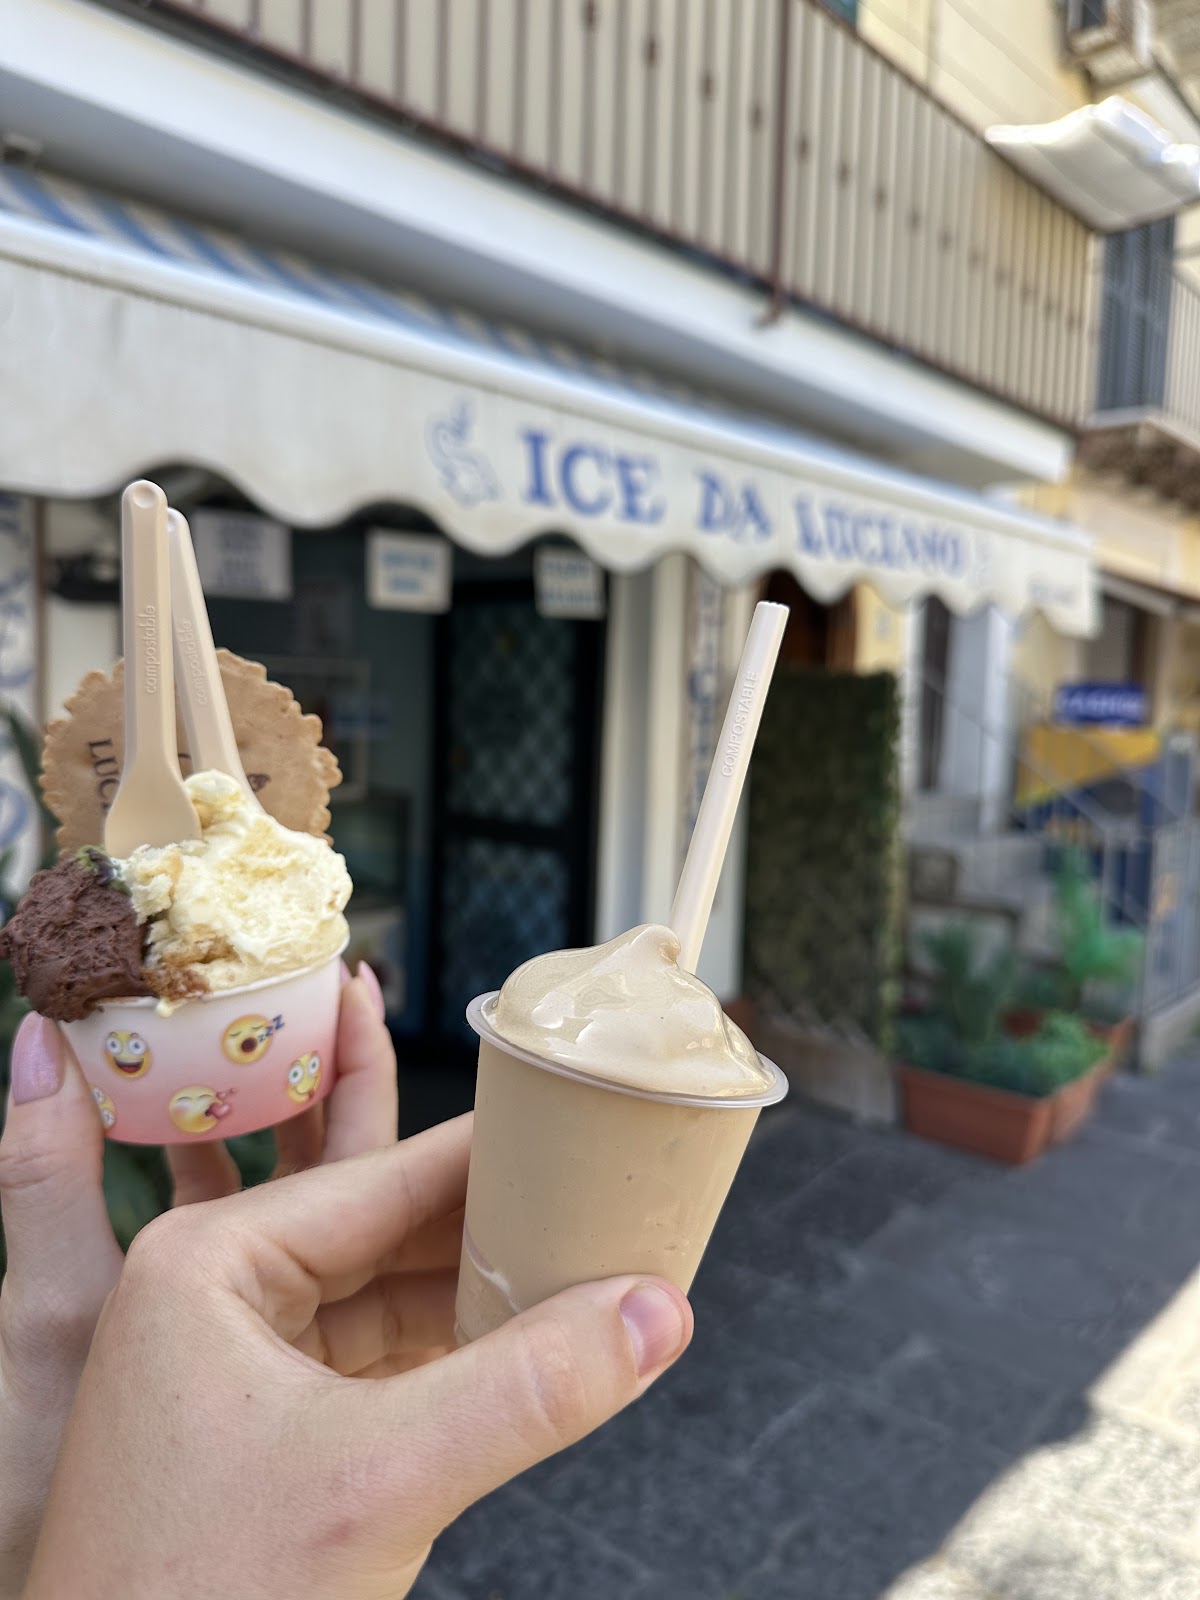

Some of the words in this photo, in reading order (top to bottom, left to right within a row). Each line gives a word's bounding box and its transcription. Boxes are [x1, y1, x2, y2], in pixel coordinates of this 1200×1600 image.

[520, 428, 667, 525] ICE
[697, 467, 774, 541] DA
[138, 605, 161, 694] compostable
[177, 619, 208, 705] compostable
[721, 671, 759, 778] COMPOSTABLE
